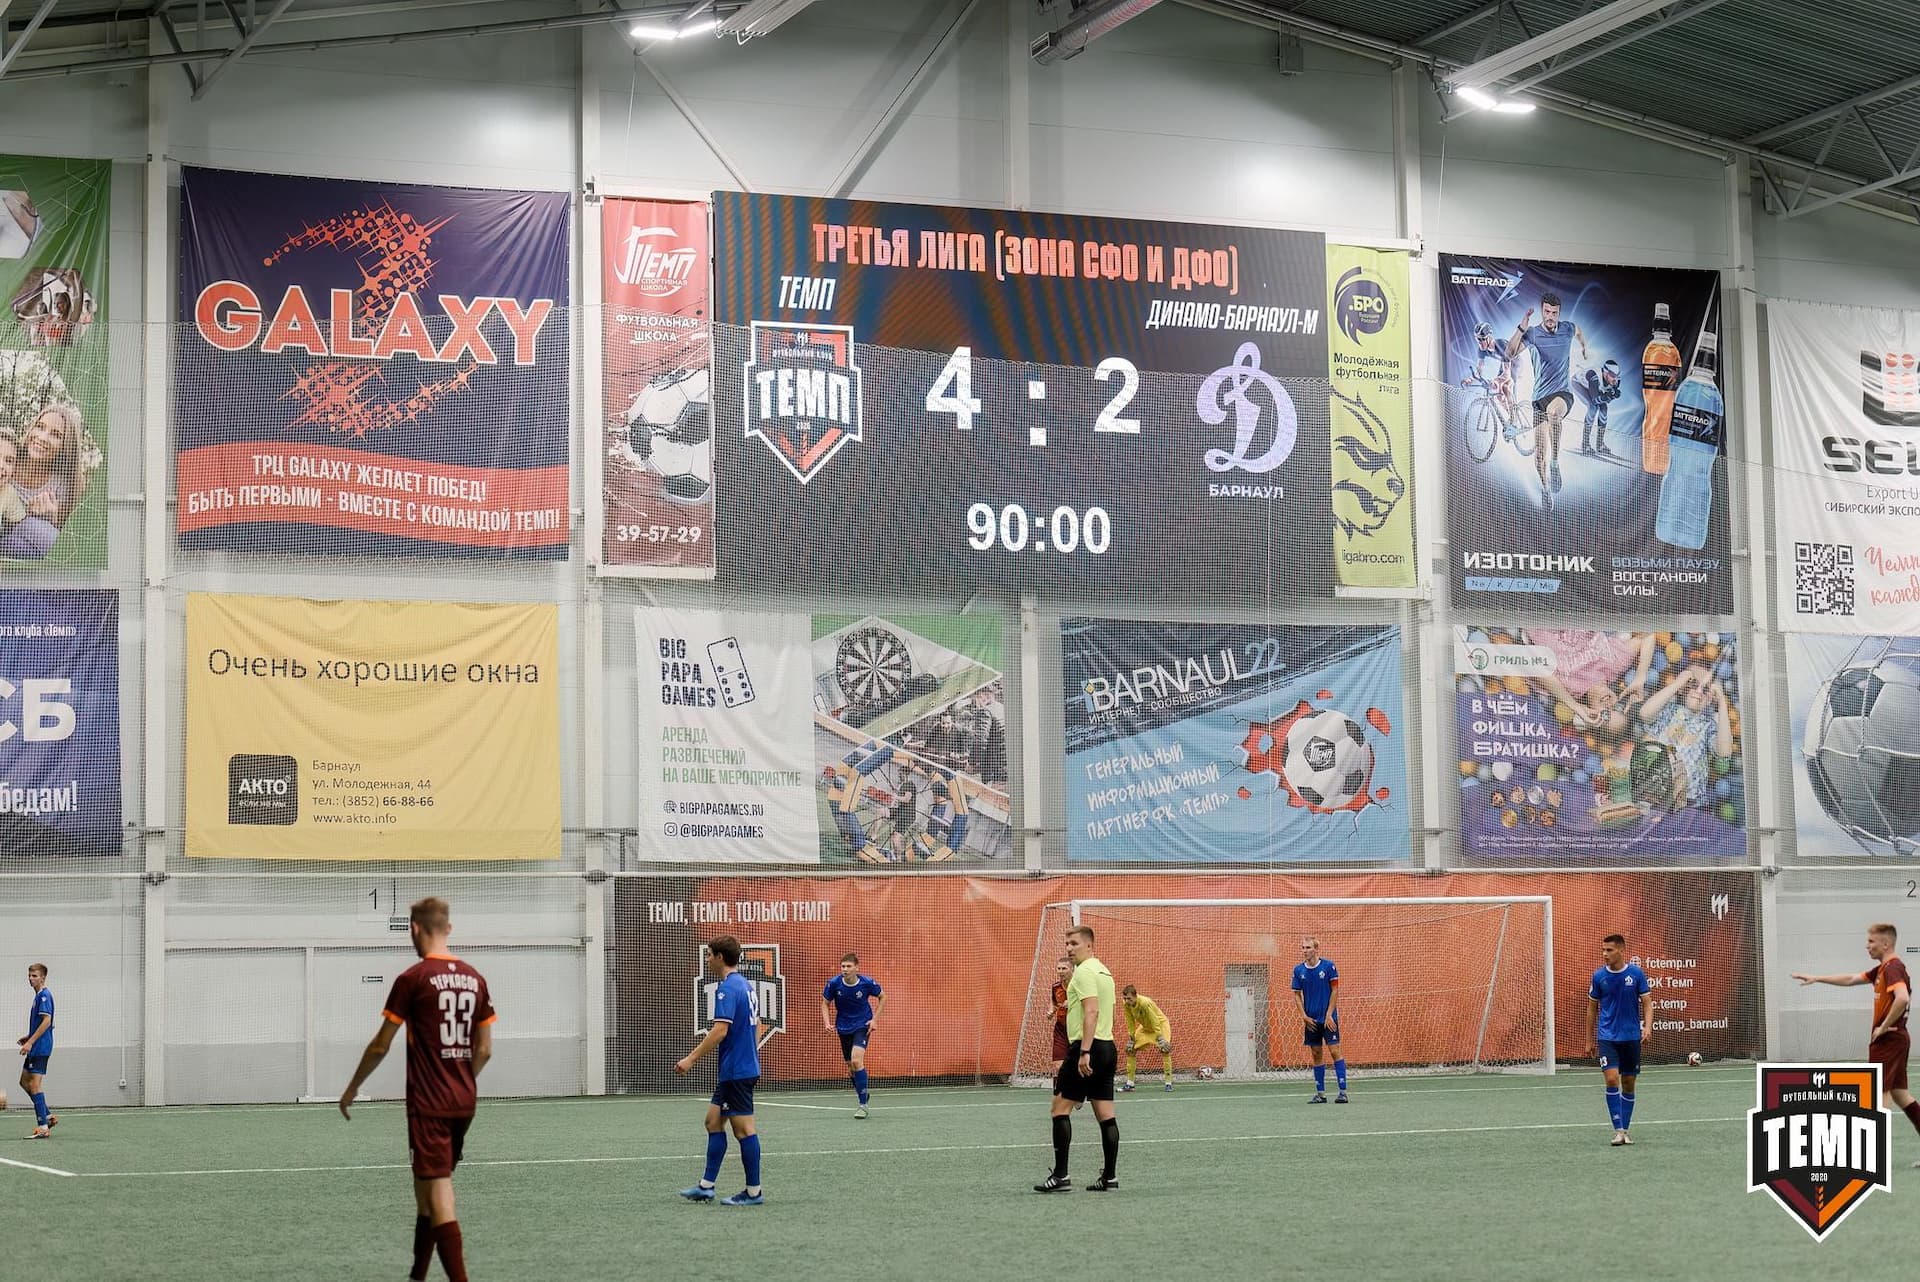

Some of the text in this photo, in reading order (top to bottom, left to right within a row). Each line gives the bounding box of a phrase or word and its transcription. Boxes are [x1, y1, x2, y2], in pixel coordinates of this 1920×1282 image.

[812, 223, 1240, 296] ТРЕТЬЯ ЛИГА (ЗОНА СФО И ДФО)
[778, 275, 837, 311] ТЕМП
[194, 279, 553, 365] GALAXY
[615, 314, 699, 328] ФУТБОЛЬНАЯ
[1145, 299, 1320, 335] ДИНАМО-БАРНАУЛ-М
[634, 330, 677, 342] ШКОЛА
[1333, 352, 1399, 369] Молодёжная
[1335, 366, 1399, 383] футбольная
[756, 368, 850, 424] ТЕМП
[925, 345, 982, 430] 4
[1094, 356, 1141, 434] 2
[252, 455, 487, 503] ТРЦ GALAXY ЖЕЛАЕТ ПОБЕД!
[1208, 483, 1285, 500] БАРНАУЛ
[1866, 484, 1907, 502] Export
[188, 487, 234, 515] БЫТЬ
[238, 484, 322, 509] ПЕРВЫМИ
[338, 491, 402, 521] ВМЕСТЕ
[406, 501, 417, 522] С
[421, 504, 510, 533] КОМАНДОЙ
[514, 508, 561, 531] ТЕМП!
[1824, 501, 1886, 516] СИБИРСКИЙ
[616, 525, 702, 545] 39-57-29
[966, 502, 1112, 555] 90:00
[1463, 551, 1595, 574] ИЗОТОНИК
[1612, 557, 1671, 569] ВОЗЬМИ
[1613, 571, 1707, 583] ВОССТАНОВИ
[1614, 585, 1658, 596] СИЛЫ.
[15, 624, 41, 638] клуба
[44, 624, 77, 637] «Темп»
[660, 637, 686, 659] BIG
[208, 648, 539, 687] Очень хорошие окна
[1494, 655, 1529, 665] ГРИЛЬ
[661, 660, 702, 684] PAPA
[662, 684, 716, 708] GAMES
[1472, 694, 1528, 716] В ЧЁМ
[662, 726, 708, 744] АРЕНДА
[1473, 720, 1551, 741] ФИШКА,
[662, 746, 746, 765] РАЗВЛЕЧЕНИЙ
[1473, 741, 1580, 759] БРАТИШКА?
[312, 760, 361, 773] Барнаул
[1085, 739, 1184, 781] ГЕНЕРАЛЬНЫЙ
[312, 778, 431, 791] ул. Молодежная, 44
[662, 767, 801, 787] НА ВАШЕ МЕРОПРИЯТИЕ
[1087, 761, 1220, 812] ИНФОРМАЦИОННЫЙ
[312, 795, 434, 808] тел.: (3852) 66-88-66
[680, 801, 764, 817] BIGPAPAGAMES.RU
[313, 813, 397, 824] www.akto.info
[1087, 792, 1230, 841] ПАРТНЕР ФК «ТЕМП»
[680, 823, 764, 839] @BIGPAPAGAMES
[1907, 880, 1917, 898] 2
[368, 888, 378, 910] 1
[648, 901, 831, 925] ТЕМП, ТЕМП, ТОЛЬКО ТЕМП!
[1645, 956, 1697, 971] fctemp.ru
[1666, 976, 1693, 988] Темп
[1650, 998, 1688, 1011] c.temp
[438, 991, 476, 1046] 33
[1652, 1016, 1729, 1033] ctemp_barnaul
